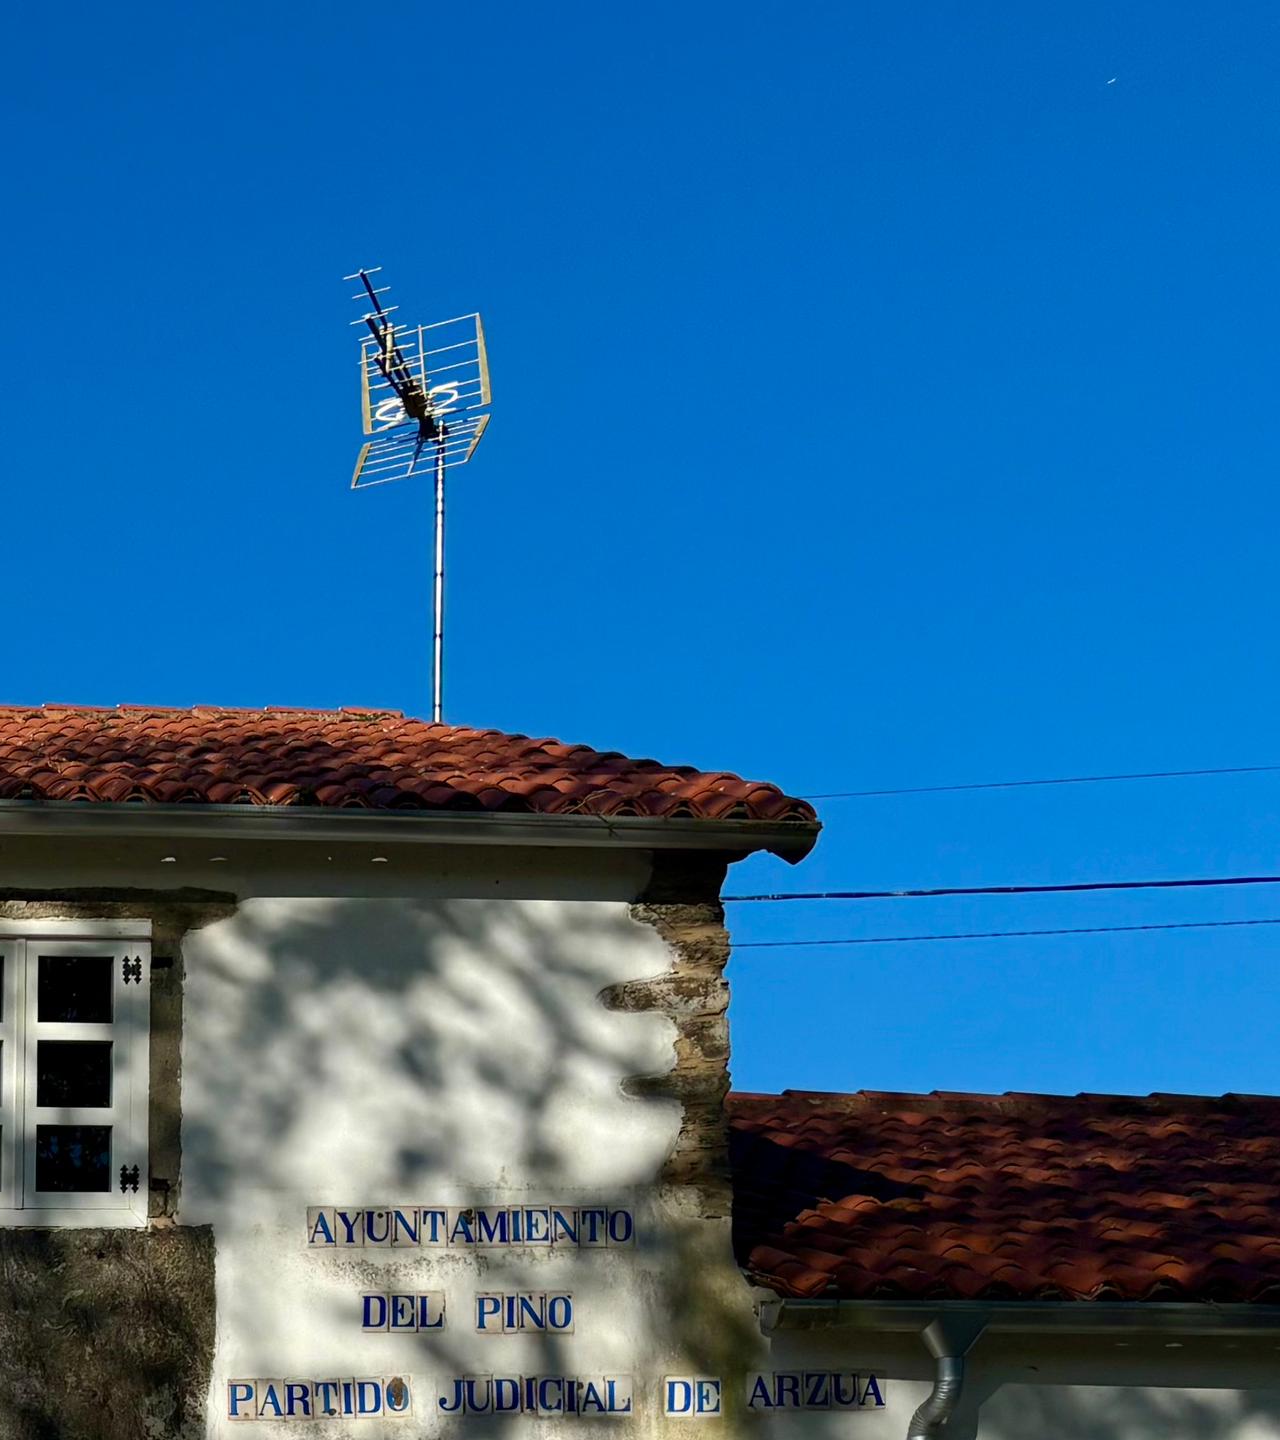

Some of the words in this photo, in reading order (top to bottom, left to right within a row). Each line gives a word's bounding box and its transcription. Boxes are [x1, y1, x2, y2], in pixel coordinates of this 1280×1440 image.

[310, 1210, 632, 1244] AYUNTAMIENTO
[362, 1295, 444, 1329] DEL
[476, 1294, 574, 1330] PINO
[228, 1379, 409, 1416] PARTIDO
[439, 1378, 632, 1413] JUDICIAL
[667, 1380, 720, 1413] DE
[748, 1373, 886, 1408] ARZUA
